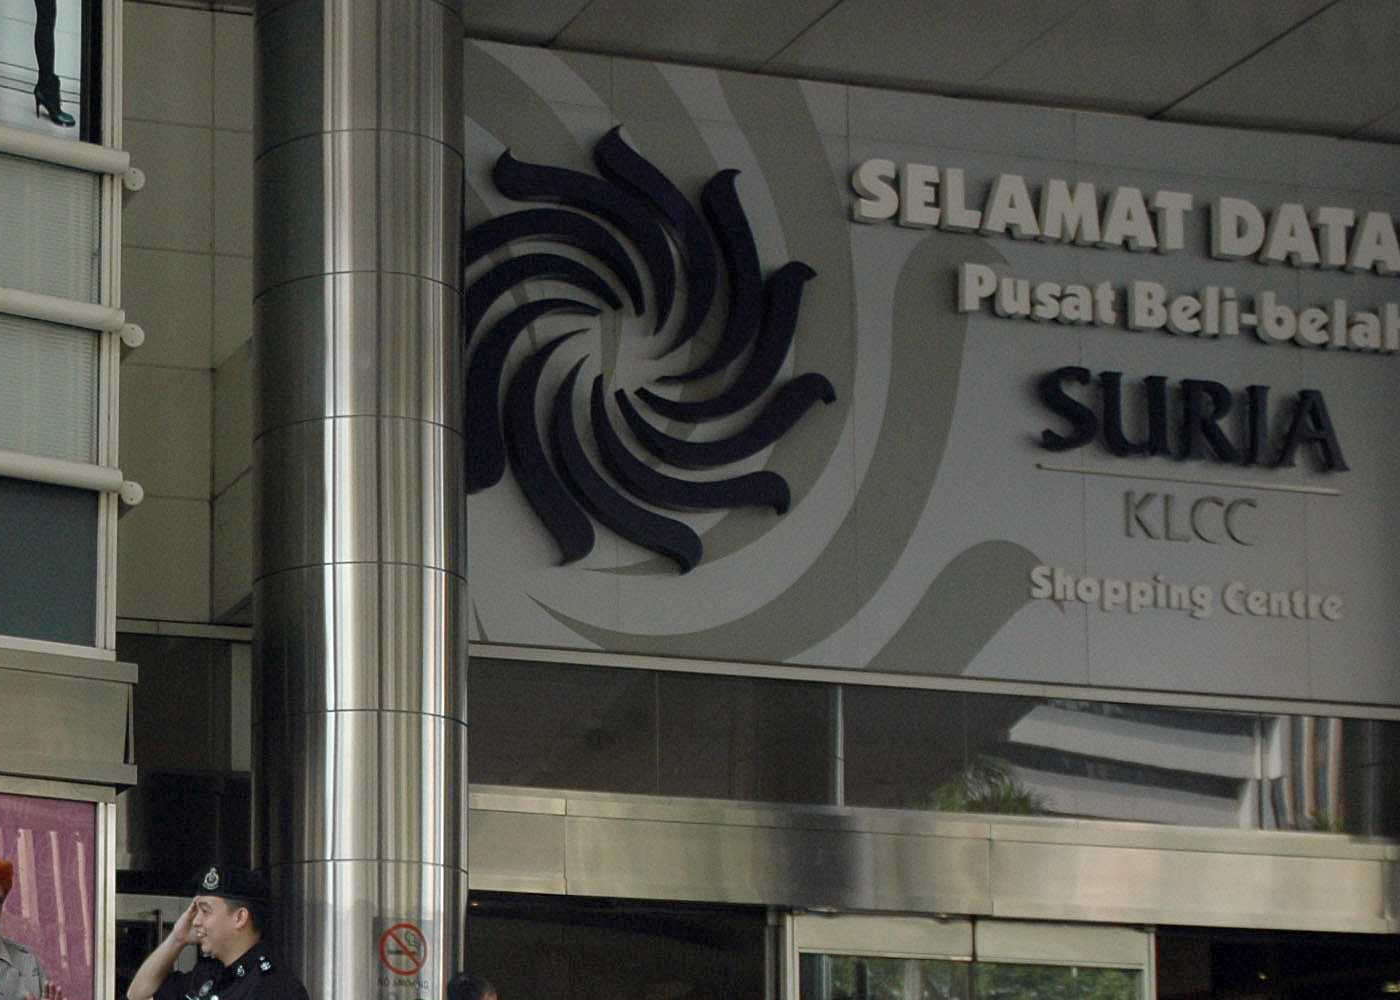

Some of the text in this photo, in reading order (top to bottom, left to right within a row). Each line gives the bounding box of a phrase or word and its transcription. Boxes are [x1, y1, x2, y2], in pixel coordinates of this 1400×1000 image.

[852, 158, 1400, 273] SELAMAT DATA
[958, 262, 1117, 326] Pusat
[1036, 366, 1350, 473] SURIA
[1123, 490, 1258, 547] KLCC
[1029, 565, 1345, 621] Shopping Centre
